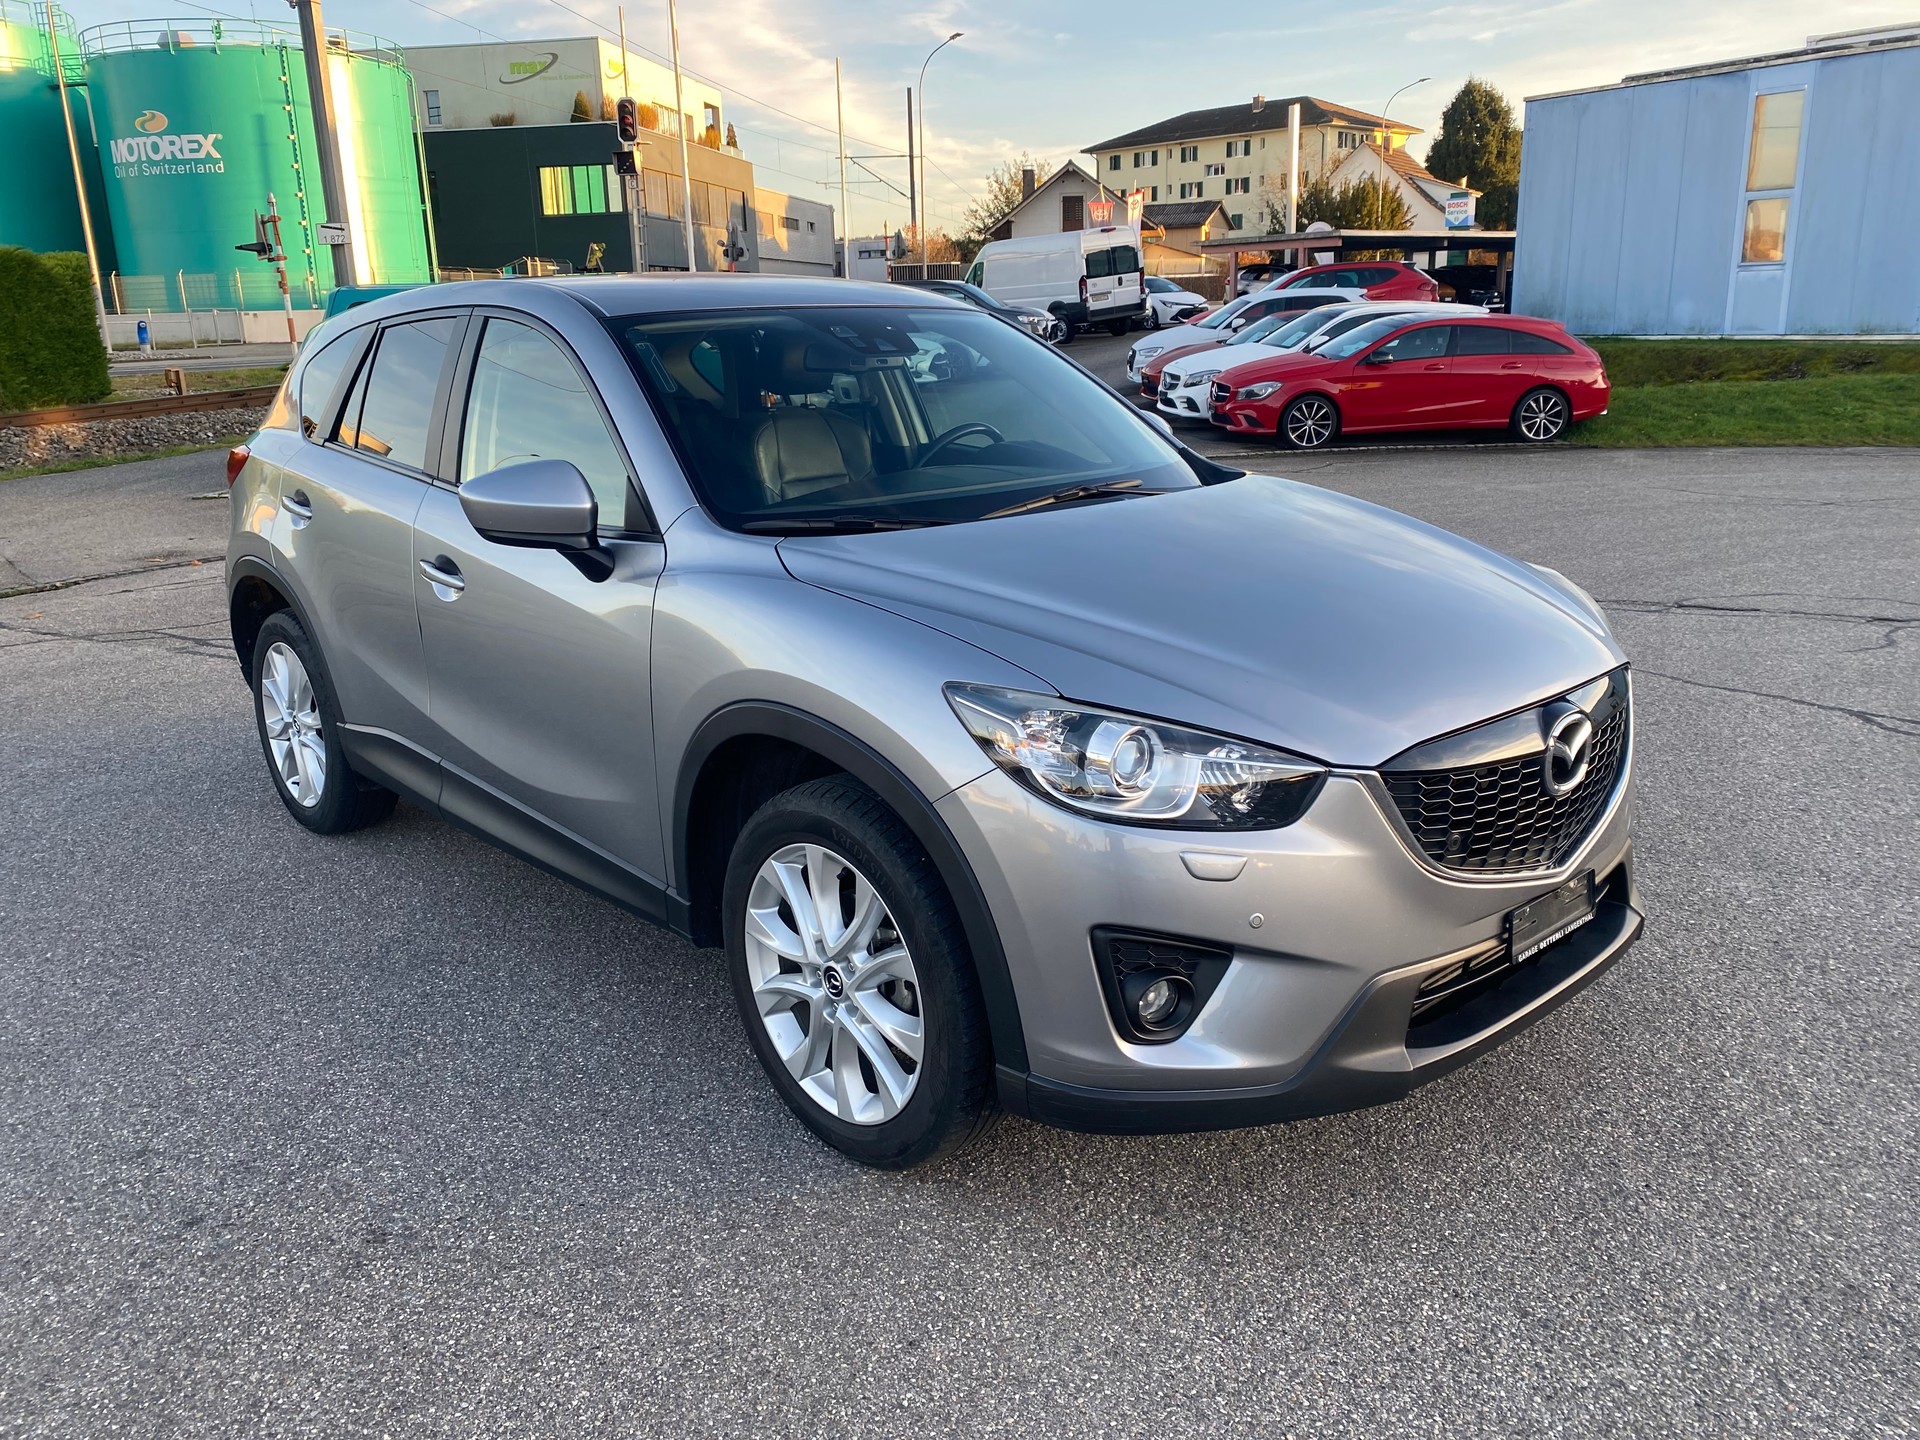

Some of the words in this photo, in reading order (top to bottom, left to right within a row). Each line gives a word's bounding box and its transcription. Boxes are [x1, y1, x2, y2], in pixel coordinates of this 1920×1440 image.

[114, 165, 126, 178] Oil
[128, 164, 139, 177] of
[142, 161, 225, 176] Switzerland
[1447, 201, 1469, 209] BOSCH
[1518, 946, 1539, 962] GARAGE
[1539, 930, 1565, 950] OETTERLI
[1565, 912, 1595, 935] LANGENTHAL
